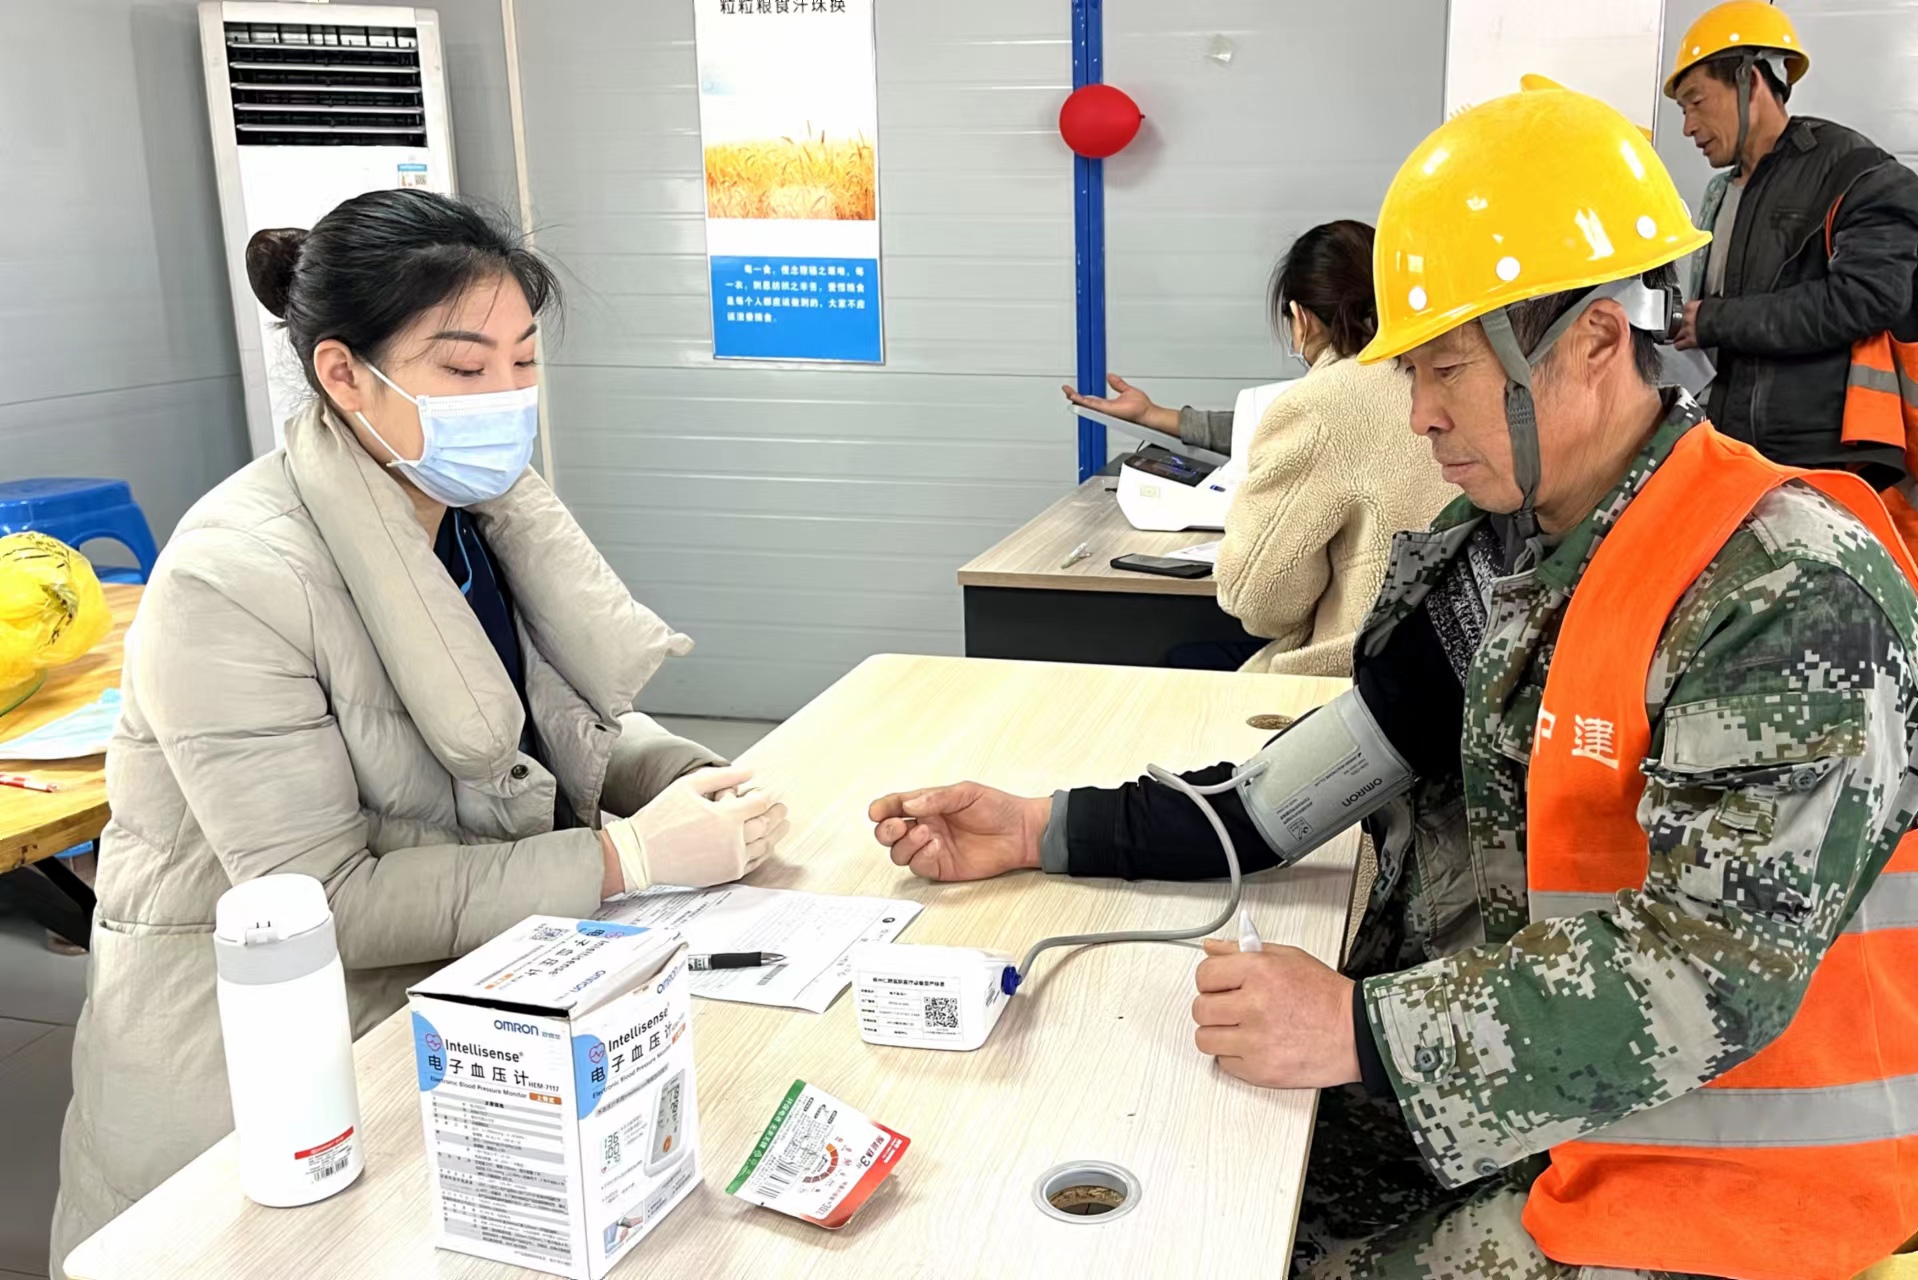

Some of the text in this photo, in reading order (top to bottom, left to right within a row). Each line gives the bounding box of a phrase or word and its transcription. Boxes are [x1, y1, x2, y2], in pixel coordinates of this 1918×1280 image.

[1342, 777, 1383, 808] OMRON
[494, 1020, 539, 1036] OMRON
[591, 1021, 672, 1083] 电子血压计
[428, 1055, 560, 1092] 电子血压计 HEM-7117
[458, 1081, 476, 1090] Blood
